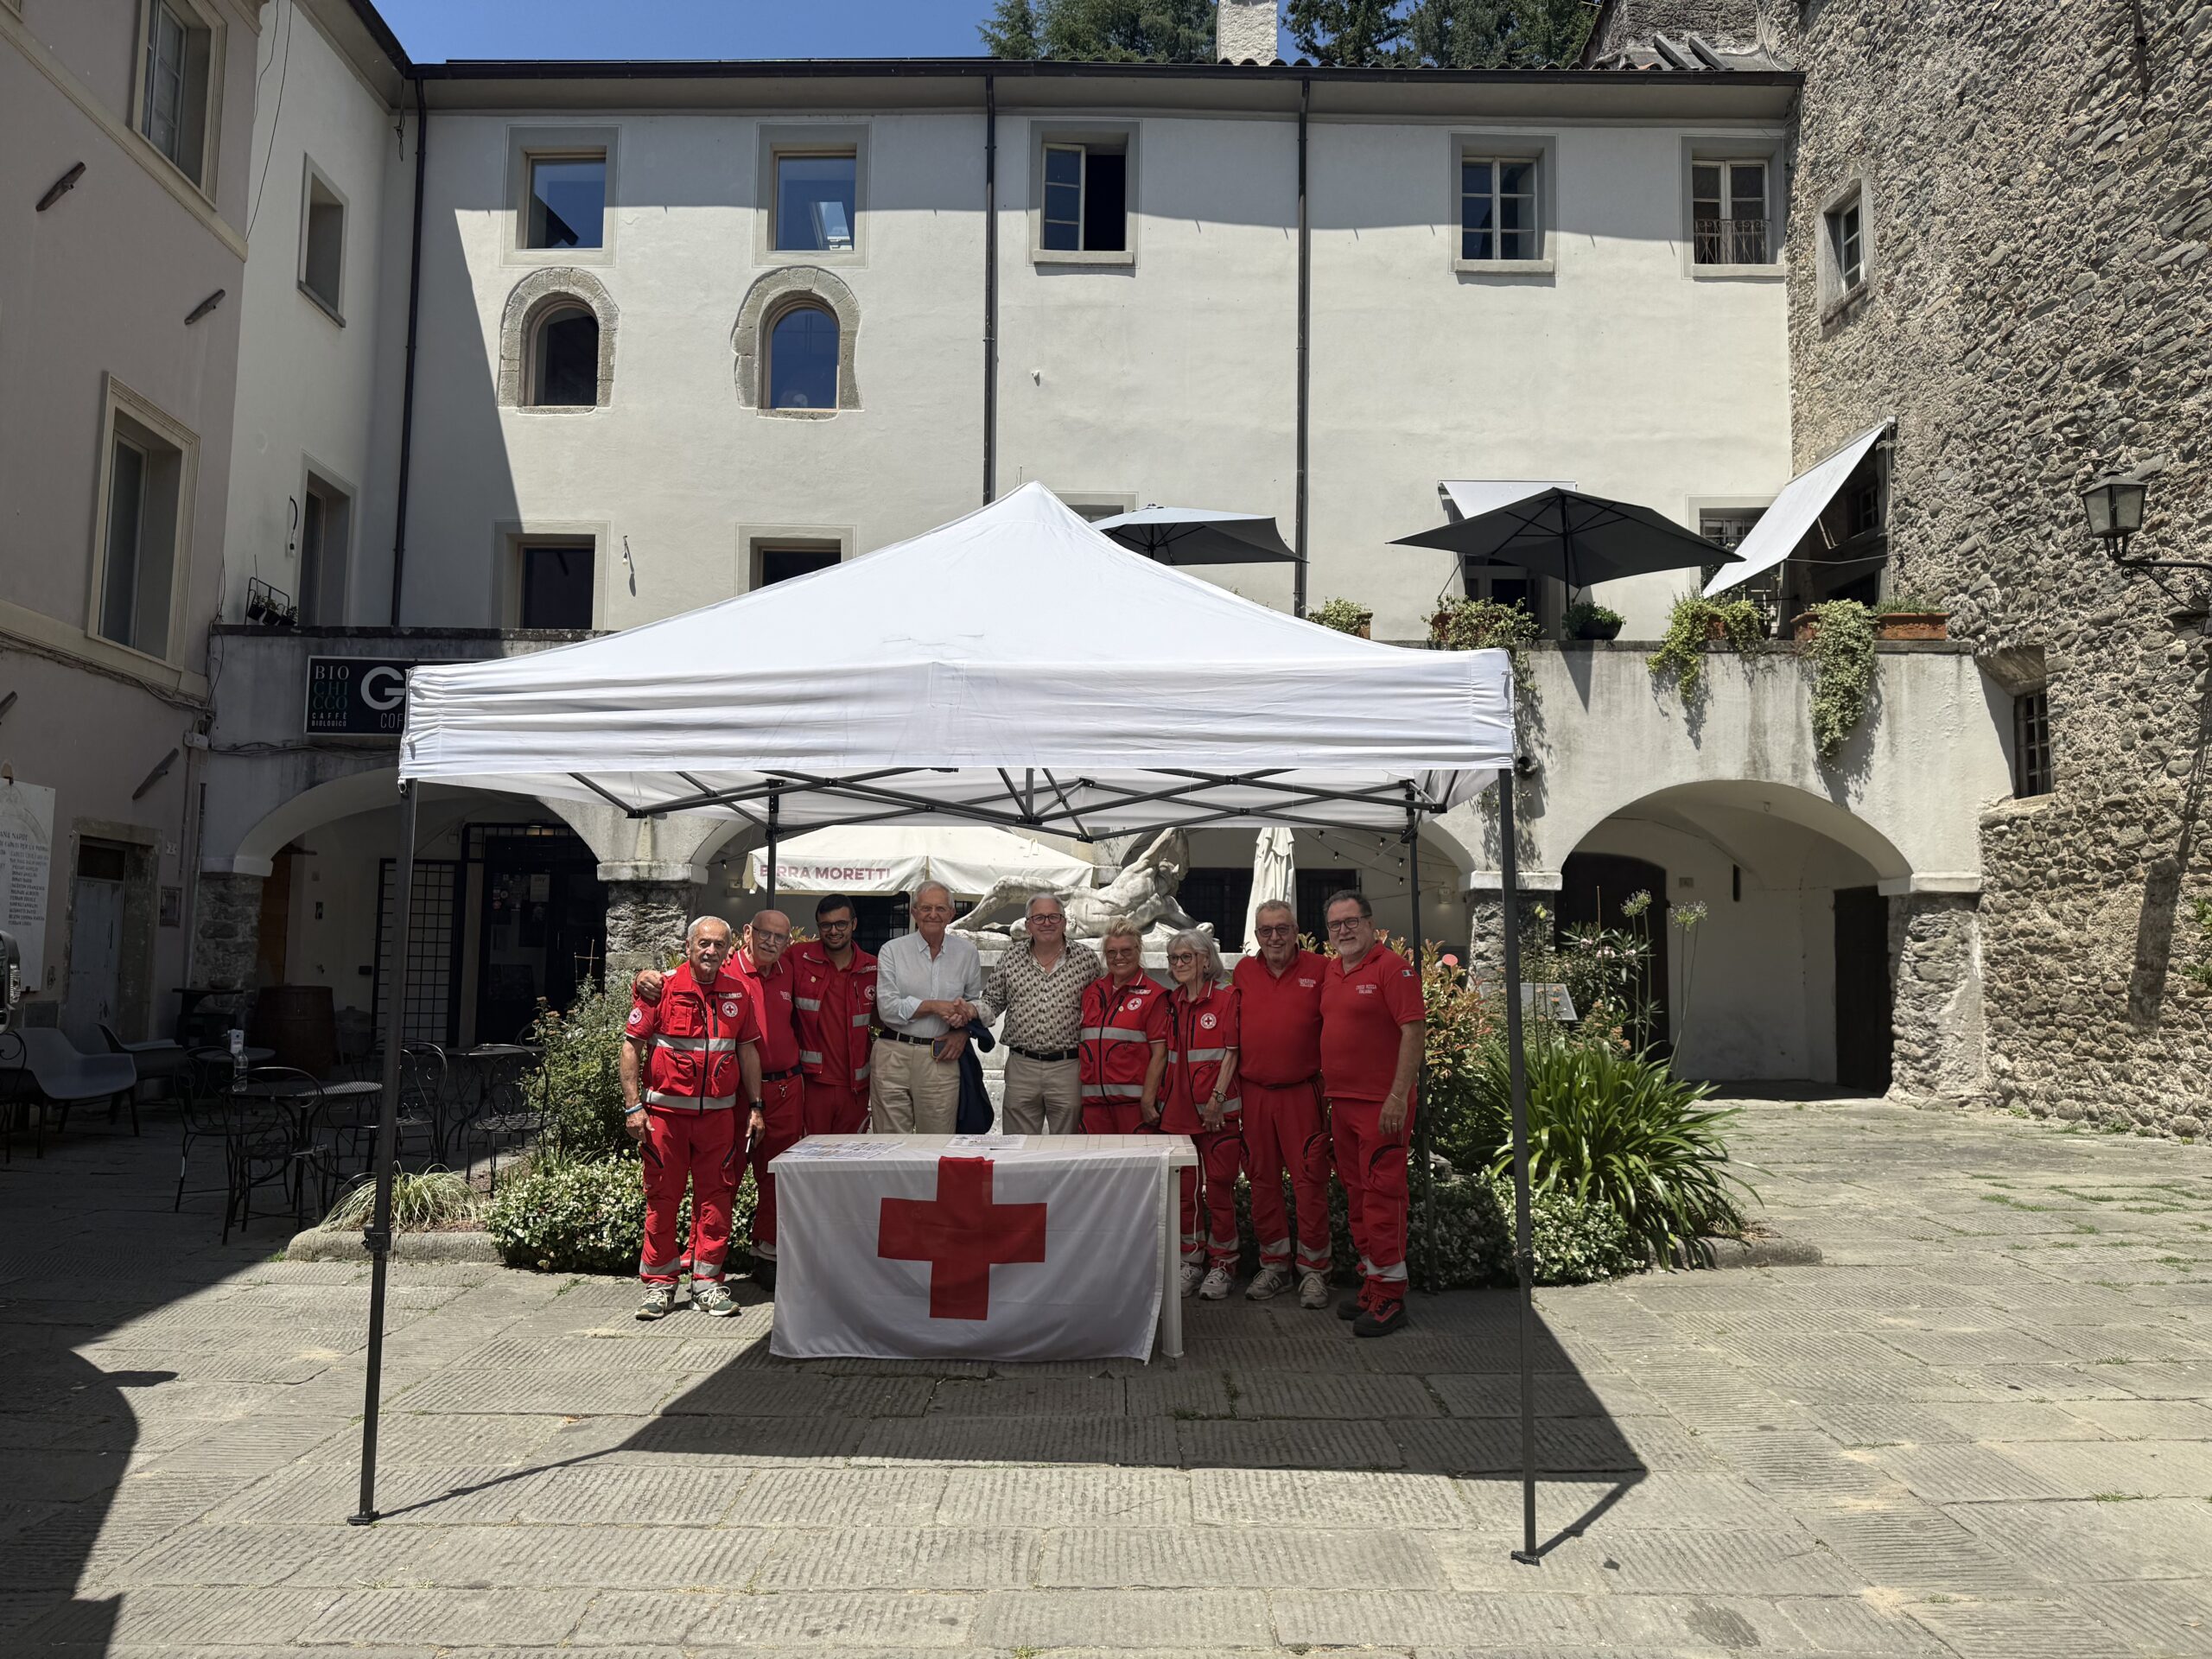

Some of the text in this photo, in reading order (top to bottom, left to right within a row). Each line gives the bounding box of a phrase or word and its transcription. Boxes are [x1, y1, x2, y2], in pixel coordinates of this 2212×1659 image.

[315, 665, 349, 680] BIO
[314, 681, 347, 696] CHI
[760, 864, 891, 880] BRRA MORETTI
